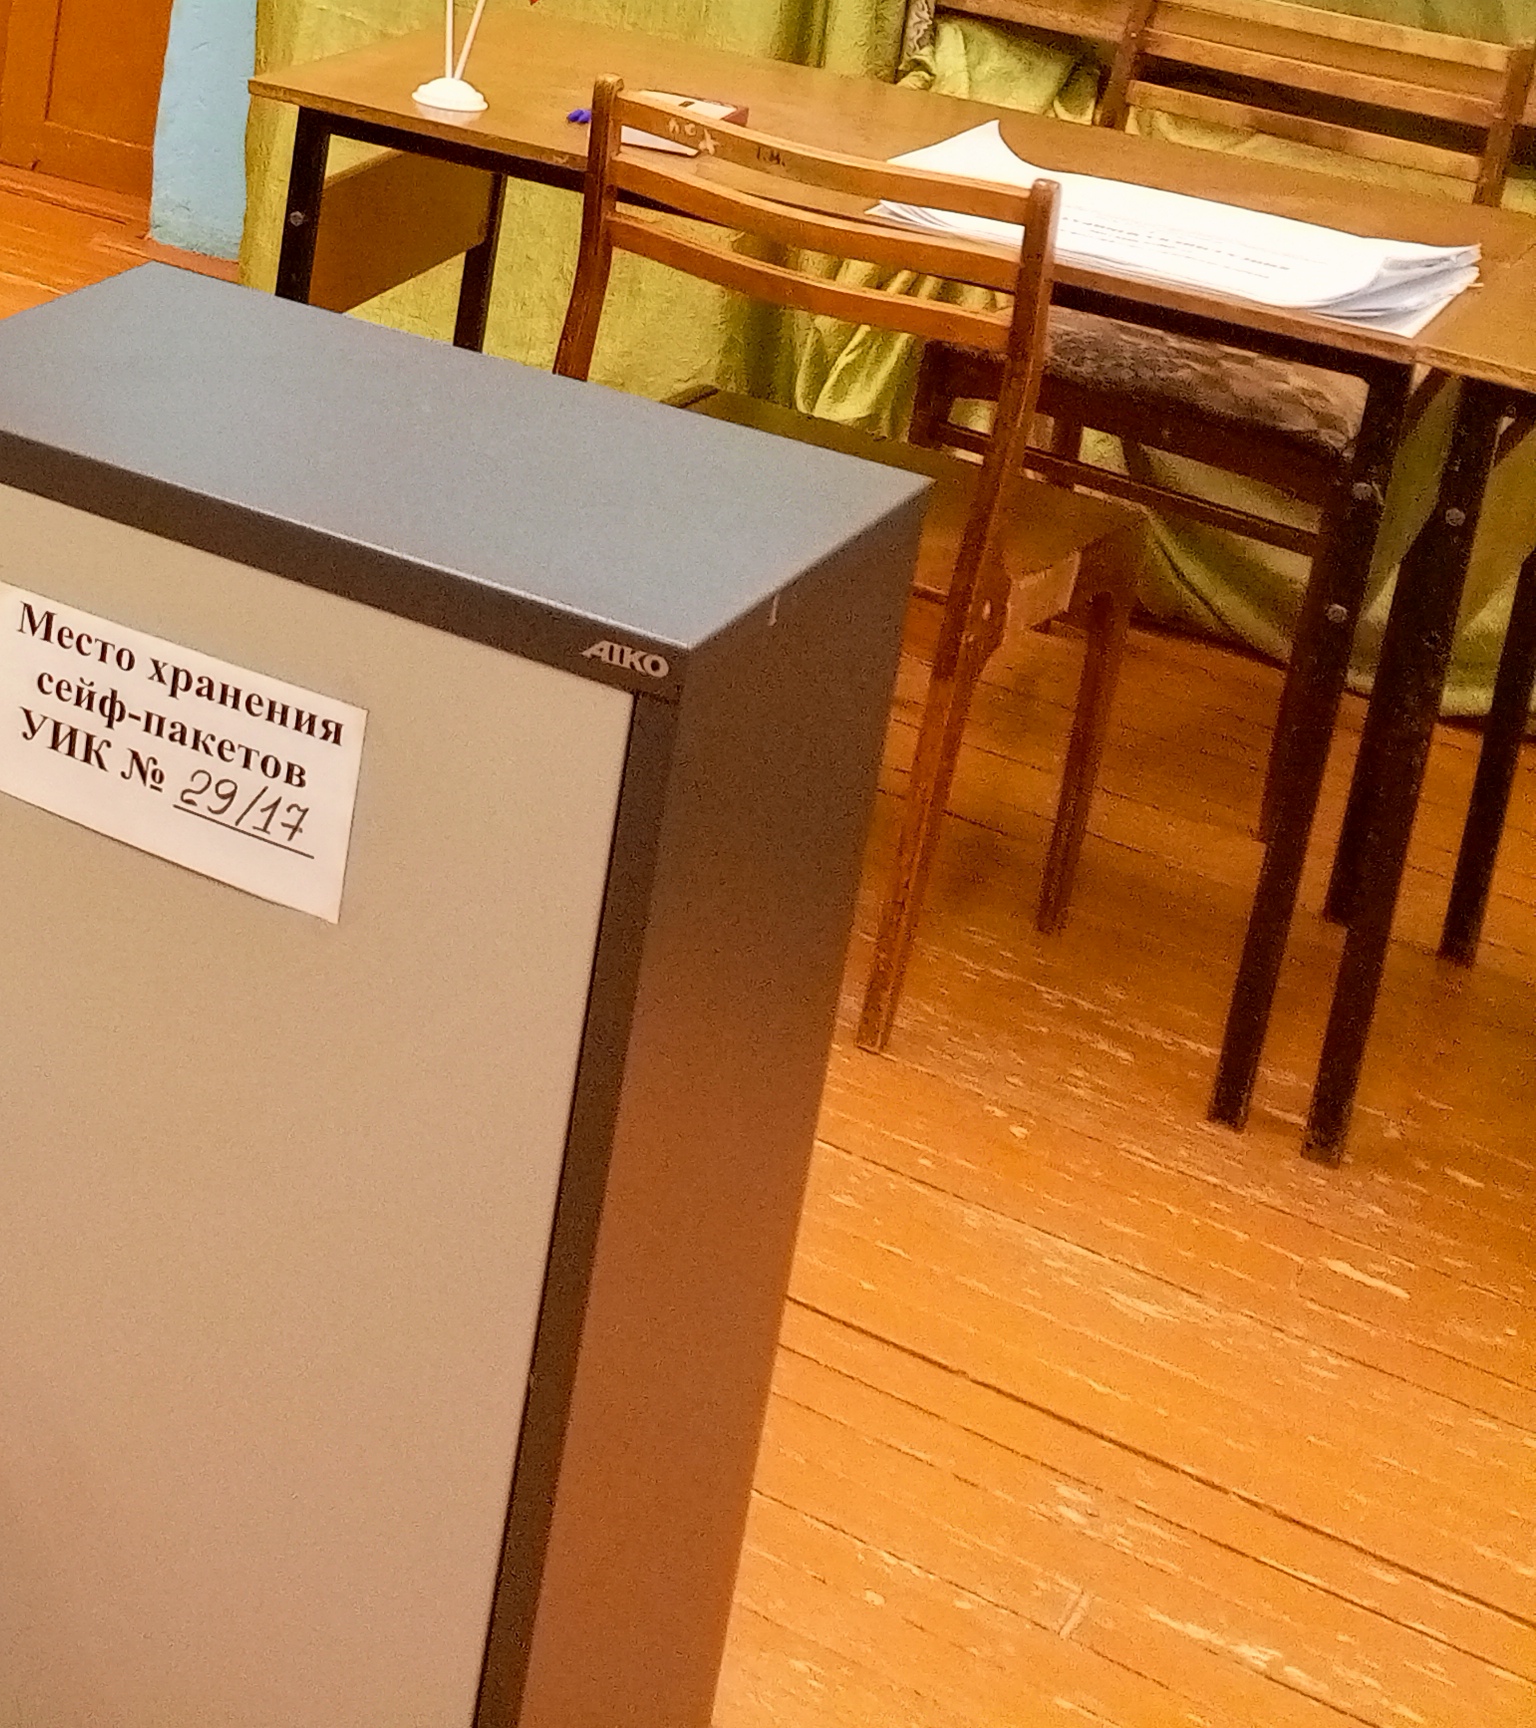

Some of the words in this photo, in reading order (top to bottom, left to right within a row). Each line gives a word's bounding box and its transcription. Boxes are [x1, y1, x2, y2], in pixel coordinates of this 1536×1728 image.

[16, 600, 137, 674] Место
[147, 656, 346, 748] хранения
[580, 639, 671, 679] AIKO
[18, 705, 112, 774] УИК
[119, 749, 167, 794] №
[174, 767, 312, 844] 29/17
[35, 670, 309, 790] сейф-пакетов
